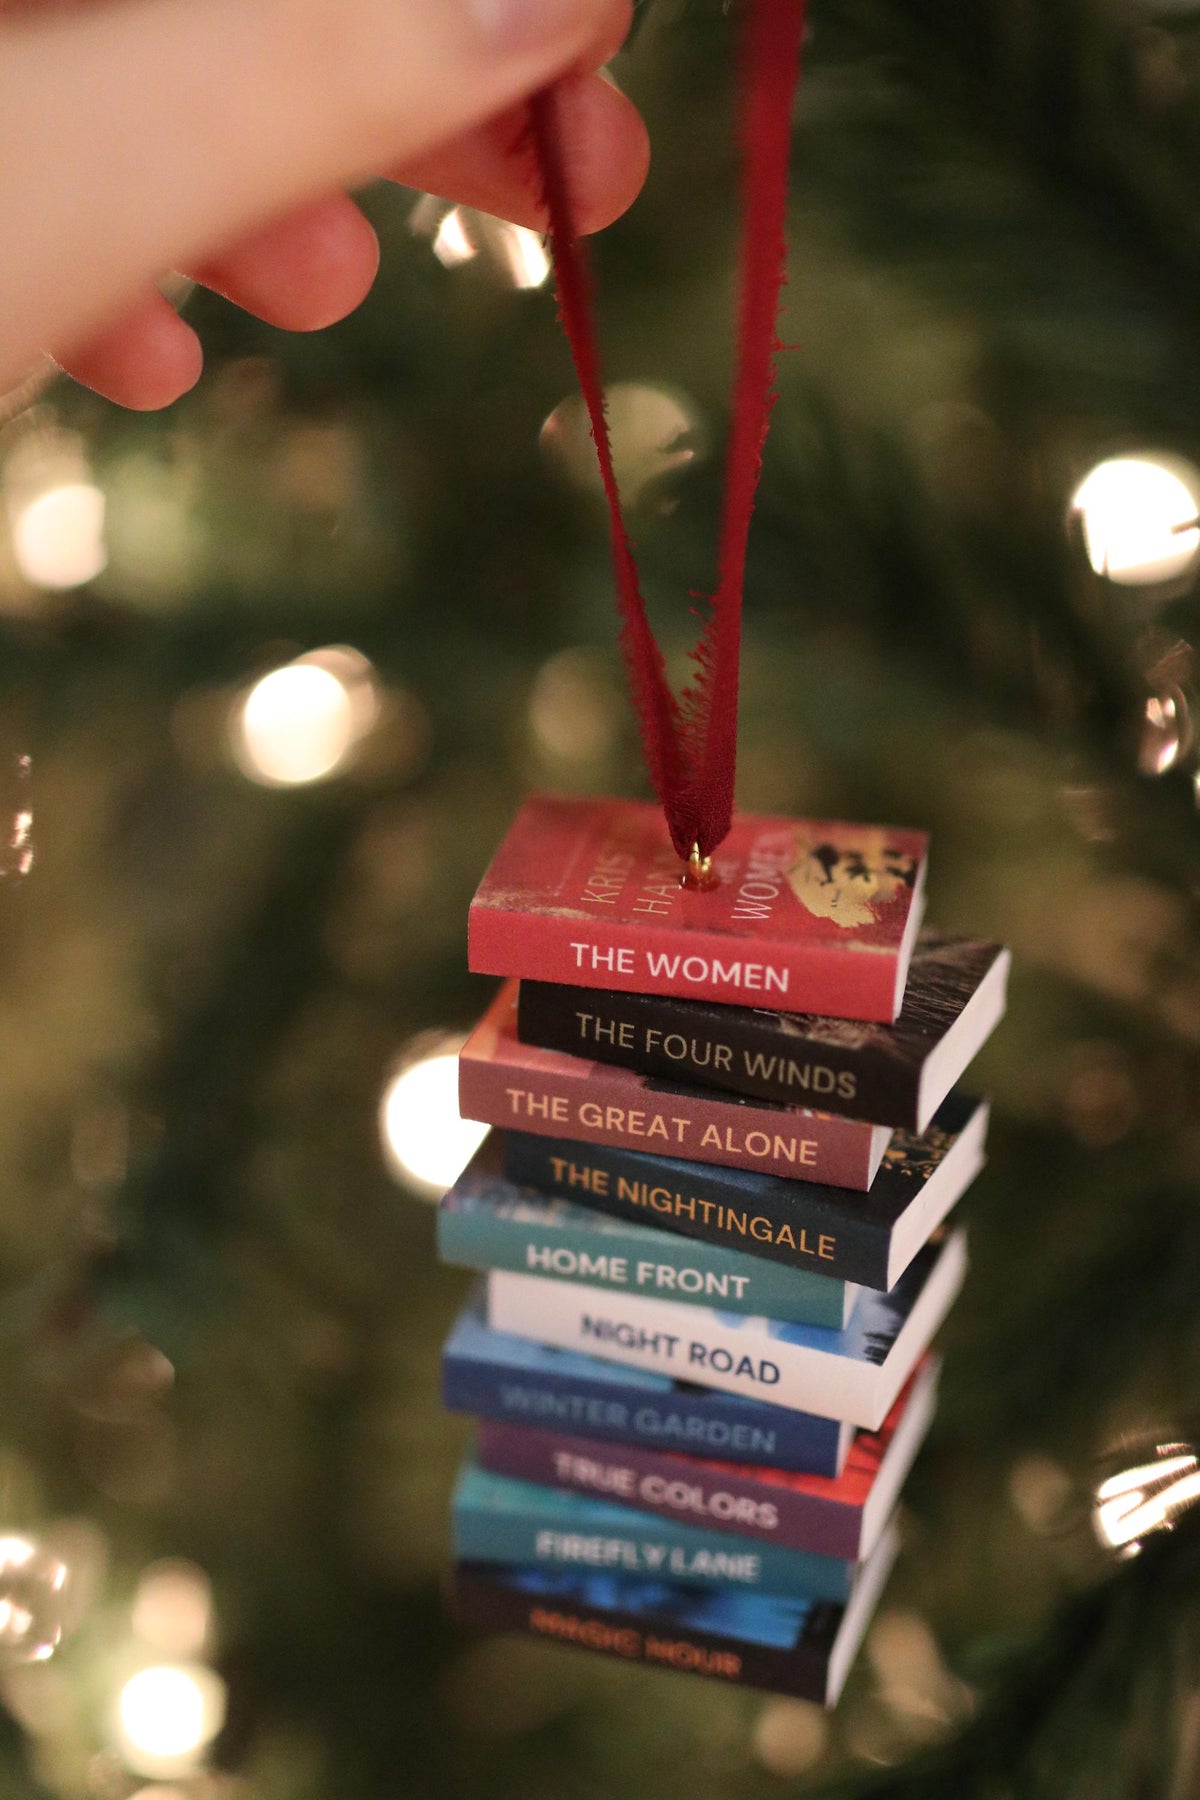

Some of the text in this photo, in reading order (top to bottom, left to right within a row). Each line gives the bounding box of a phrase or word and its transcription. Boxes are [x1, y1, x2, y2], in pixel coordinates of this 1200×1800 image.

[570, 942, 789, 992] THE WOMEN
[575, 1012, 857, 1100] THE FOUR WINDS
[506, 1088, 819, 1166] THE GREAT ALONE
[549, 1157, 837, 1261] THE NIGHTINGALE
[526, 1244, 750, 1300] HOME FRONT
[581, 1314, 781, 1386] NIGHT ROAD
[501, 1384, 777, 1452] WINTER GARDEN
[554, 1450, 779, 1530] TRUE COLORS
[535, 1529, 762, 1584] FIREFLY LANE
[644, 1635, 743, 1680] HOUR
